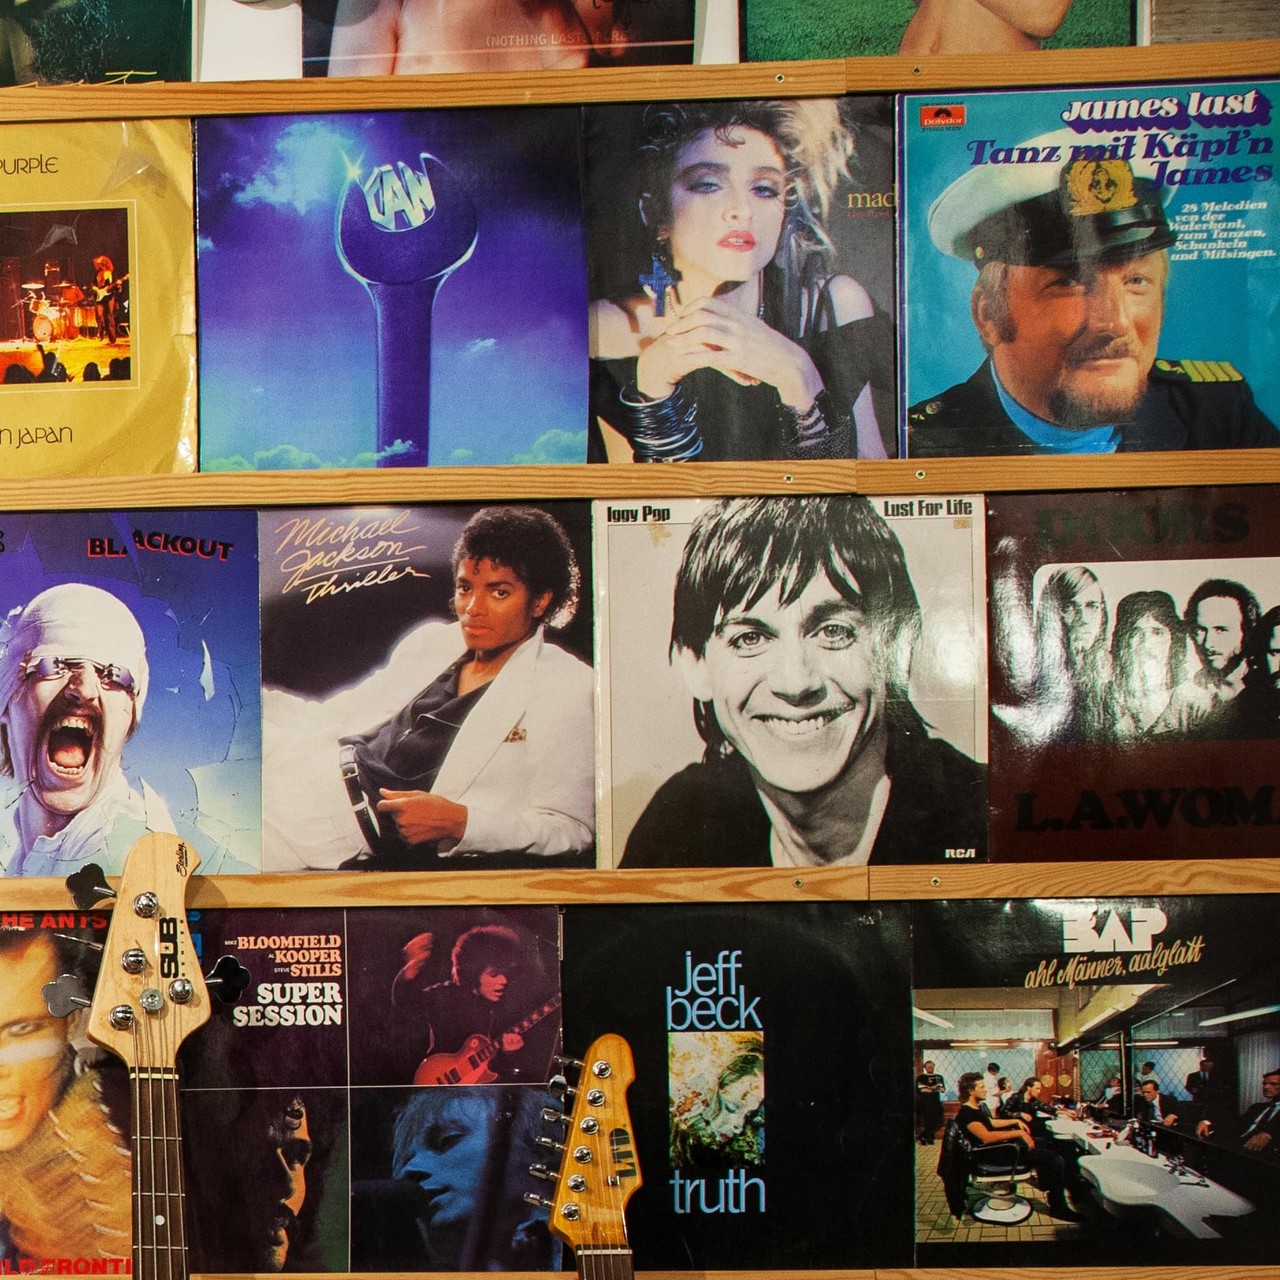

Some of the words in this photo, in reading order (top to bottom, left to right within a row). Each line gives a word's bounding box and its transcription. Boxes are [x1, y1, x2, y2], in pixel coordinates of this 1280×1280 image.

[1188, 88, 1258, 116] last
[924, 117, 963, 126] Polydor
[967, 139, 1061, 167] Tanz
[1069, 133, 1137, 163] mit
[1150, 160, 1274, 190] James
[1201, 200, 1268, 212] Melodien
[606, 504, 638, 525] Iggy
[642, 504, 672, 524] Pop
[884, 499, 915, 518] Lust
[917, 500, 944, 517] For
[946, 498, 973, 516] Life
[86, 529, 236, 563] BLACKOUT
[277, 509, 422, 555] Michael
[281, 537, 428, 595] Jackson
[306, 563, 432, 606] Thriller
[175, 842, 188, 878] Sterling
[944, 847, 976, 859] RCA
[158, 916, 179, 979] SUB
[237, 934, 342, 949] BLOOMFIELD
[275, 950, 342, 963] KOOPER
[1129, 935, 1206, 977] aalglatt
[290, 963, 342, 977] STILLS
[674, 950, 743, 997] jeff
[257, 982, 343, 1004] SUPER
[666, 985, 763, 1031] beck
[233, 1005, 343, 1027] SESSION
[669, 1169, 766, 1214] truth
